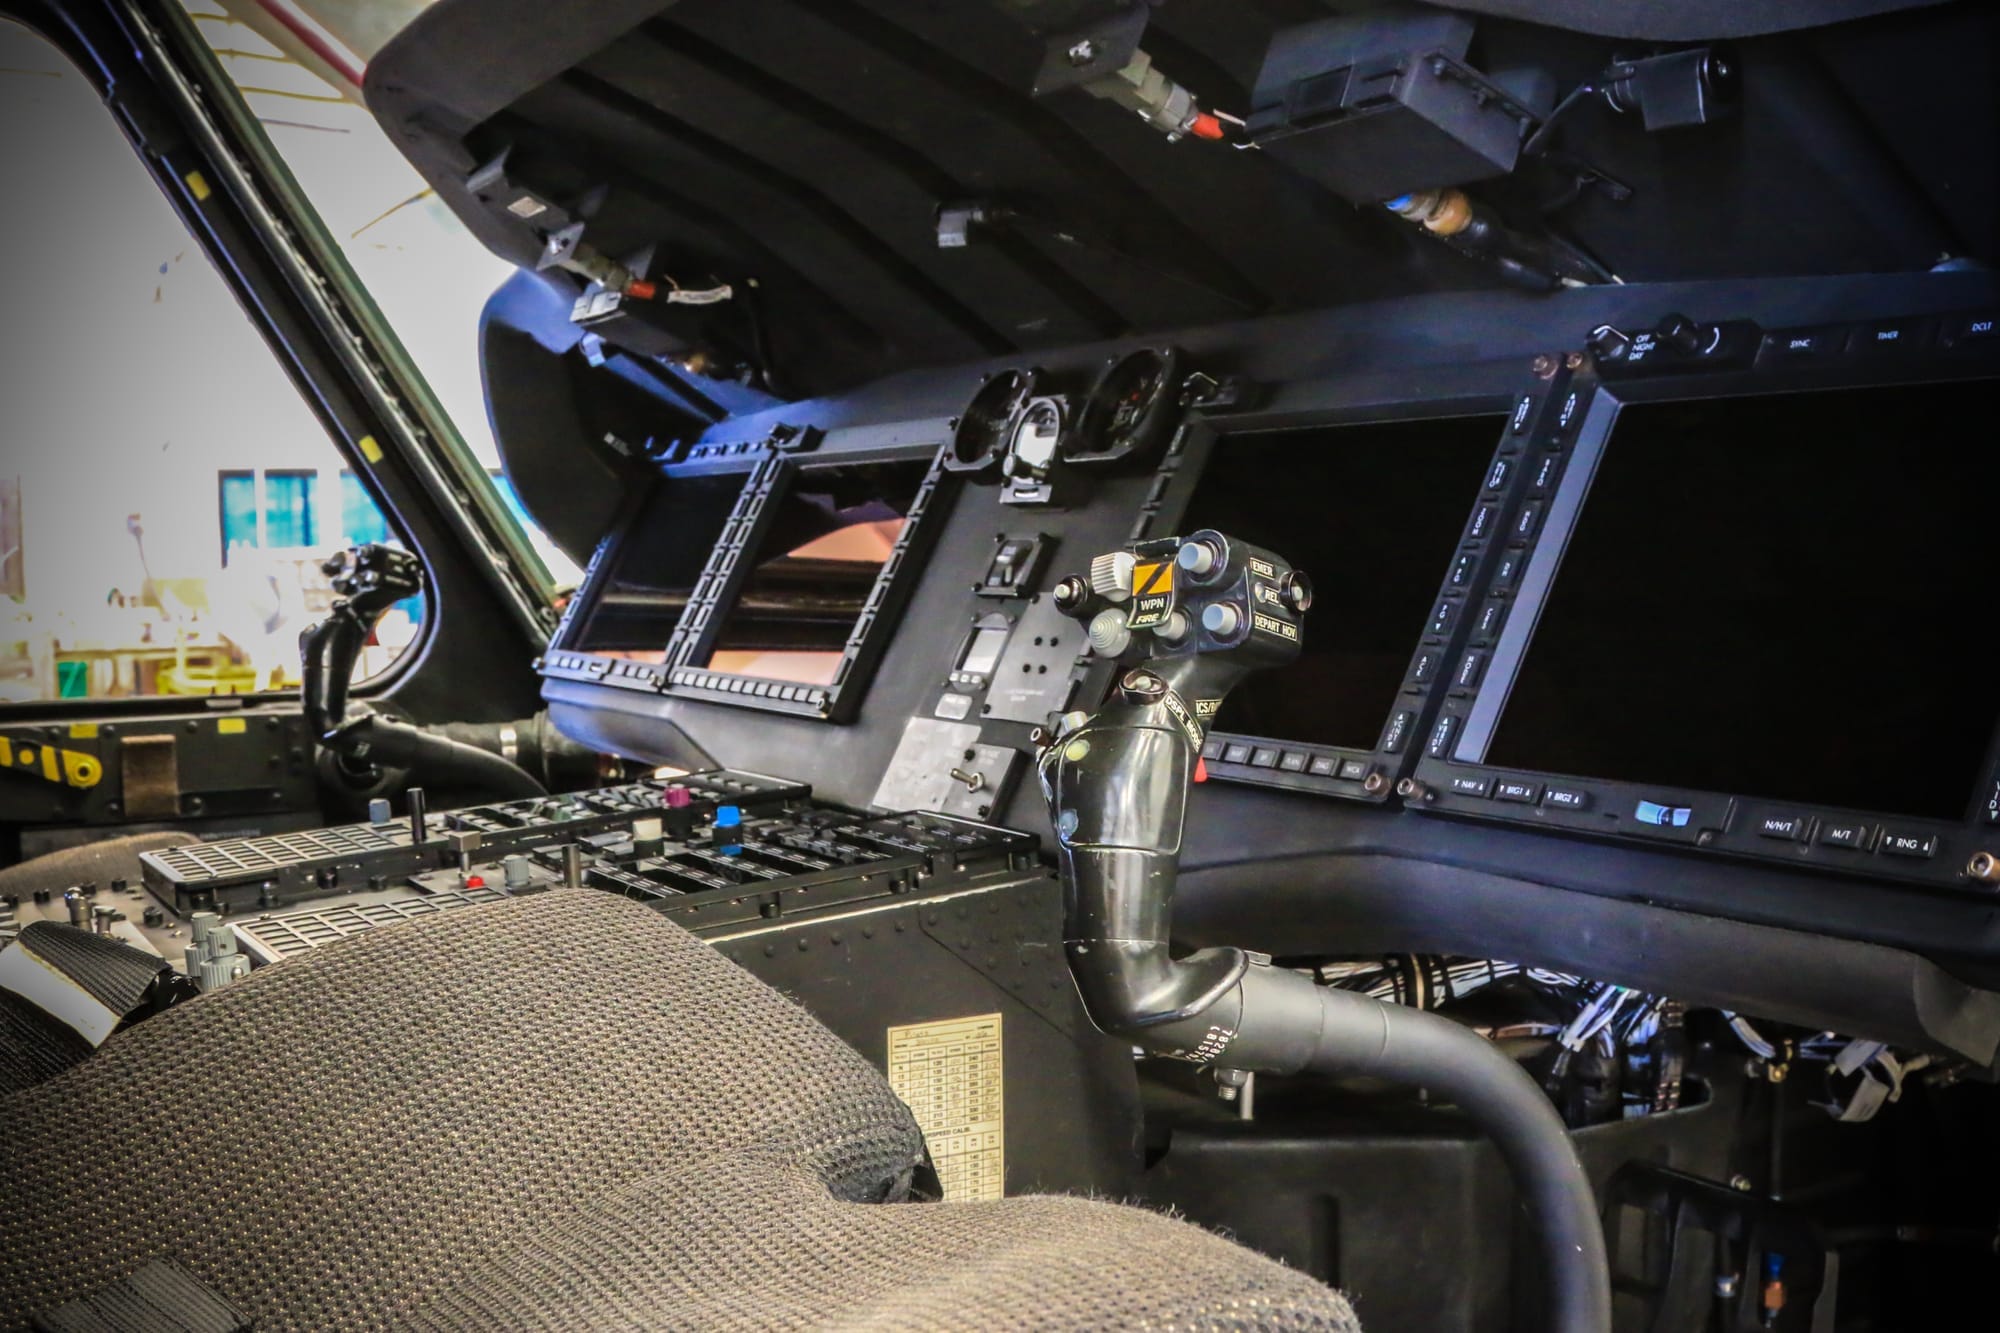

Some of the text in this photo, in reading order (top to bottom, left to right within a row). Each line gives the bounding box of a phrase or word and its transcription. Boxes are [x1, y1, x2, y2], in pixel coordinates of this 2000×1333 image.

[1252, 561, 1273, 577] EMER
[1140, 598, 1164, 610] WPN
[1135, 613, 1160, 624] FIRE
[1255, 615, 1296, 638] DEPART HOV
[1165, 696, 1203, 752] DSPL MODE
[1461, 779, 1477, 789] NAV
[1506, 785, 1524, 795] BRG1
[1554, 792, 1573, 802] BRG2
[1765, 820, 1792, 832] N/H/T
[1832, 829, 1852, 840] M/T
[1896, 838, 1918, 849] RNG
